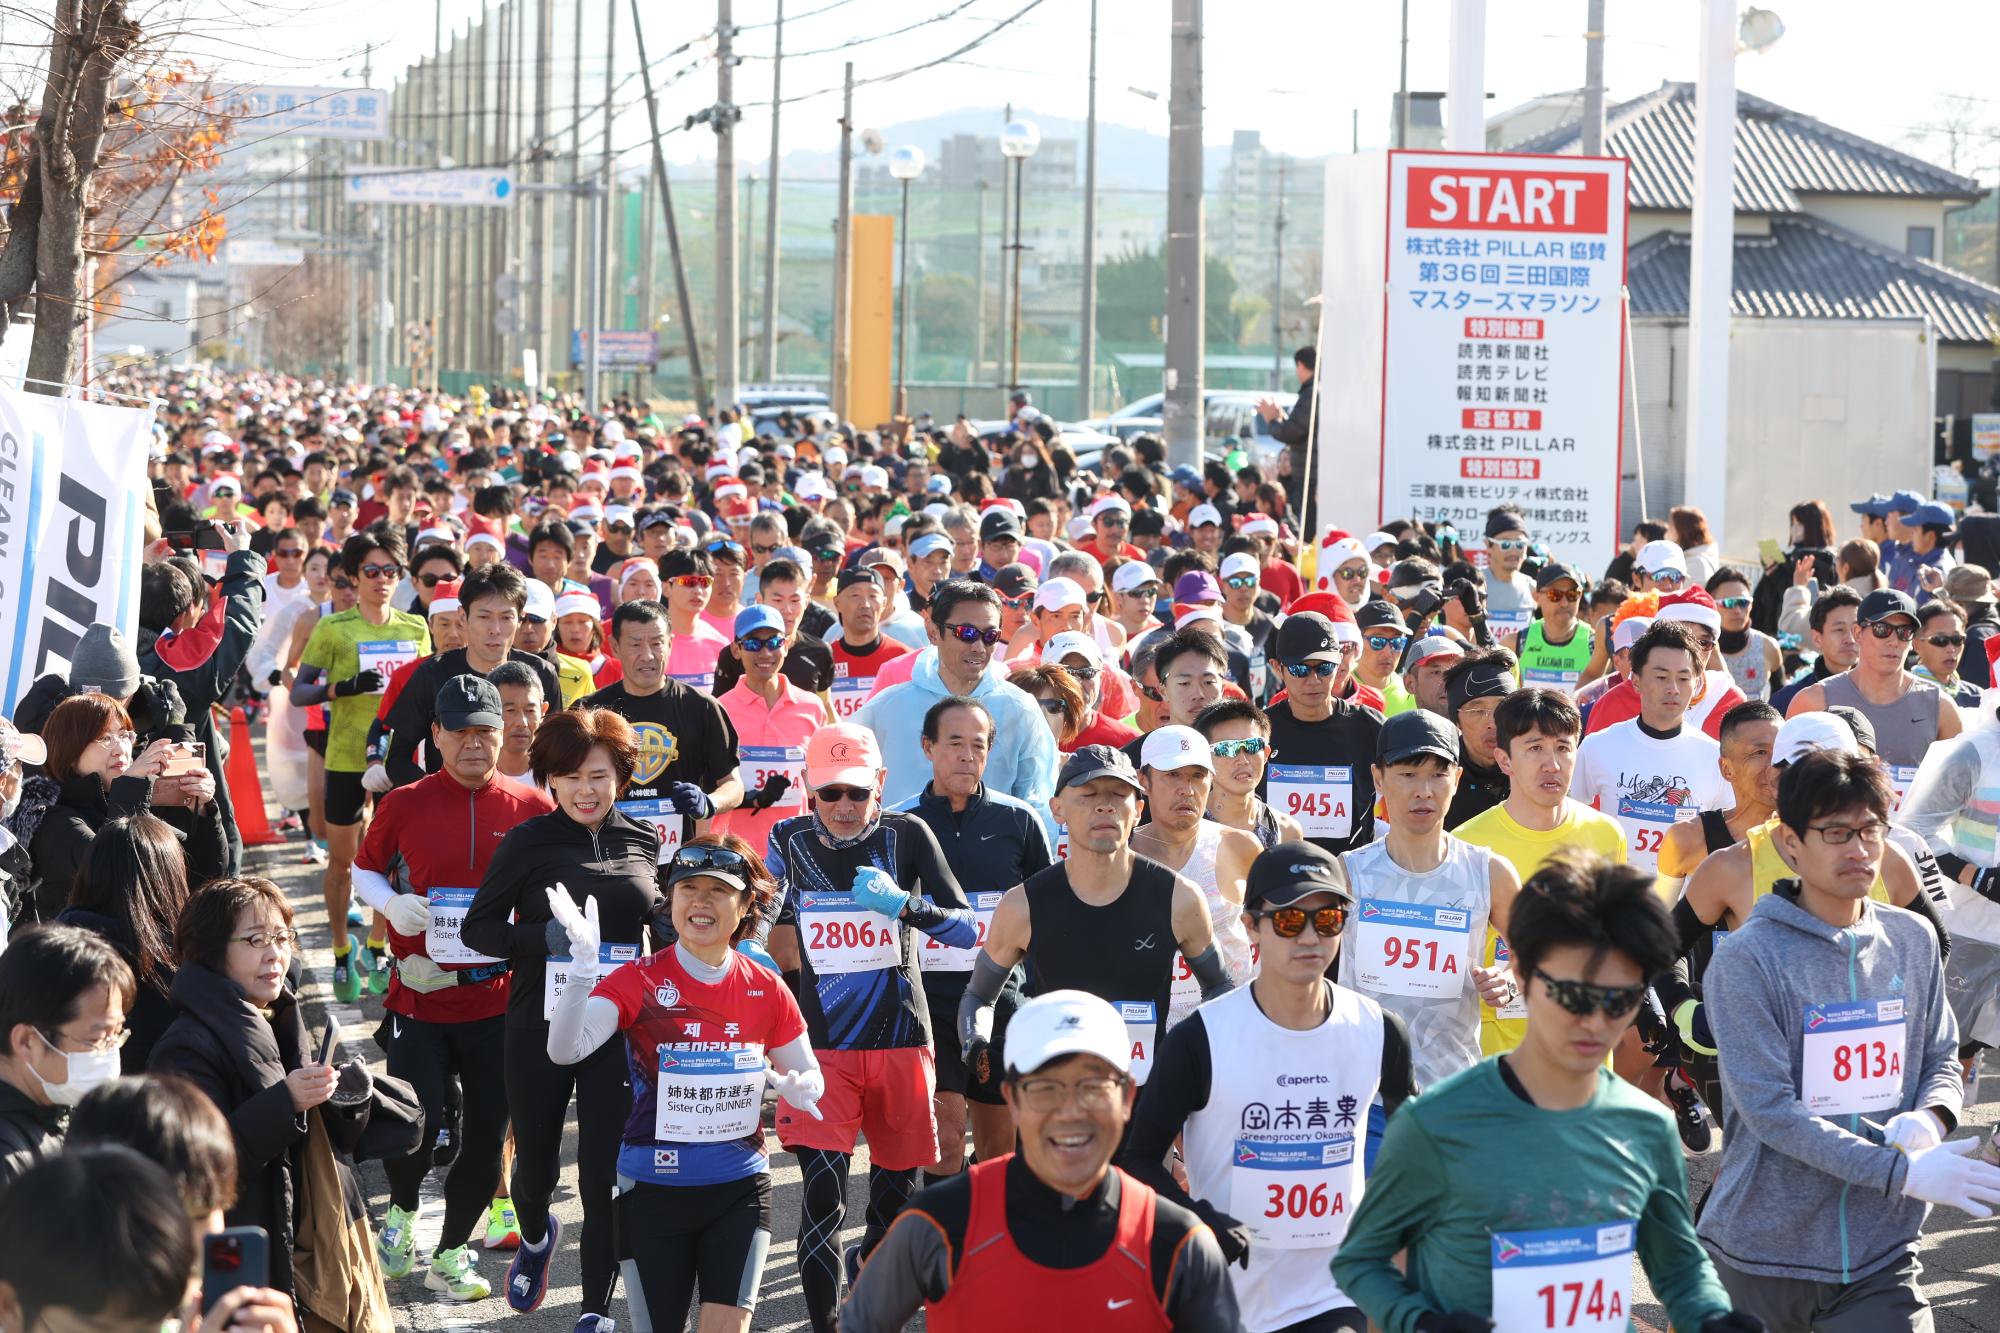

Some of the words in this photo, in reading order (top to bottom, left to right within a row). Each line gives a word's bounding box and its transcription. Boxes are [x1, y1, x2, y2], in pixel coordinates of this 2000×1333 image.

[1430, 175, 1586, 225] START
[1406, 238, 1480, 257] 株式会社
[1487, 241, 1564, 258] PILLAR
[1570, 242, 1606, 261] 協賛
[1409, 290, 1600, 313] マスターズマラソン
[1458, 343, 1549, 361] 読売新聞社
[1457, 364, 1548, 382] 読売テレビ
[1457, 385, 1548, 403] 報知新聞社
[1427, 434, 1496, 452] 株式会社
[1502, 436, 1576, 453] PILLAR
[1466, 459, 1535, 478] 特別協賛
[1410, 484, 1589, 502] 三菱電機モビリティ株式会社
[1412, 505, 1588, 523] トヨタカロー株式会社
[1287, 792, 1346, 817] 945A
[433, 929, 456, 940] Sister
[810, 921, 893, 950] 2806A
[1383, 936, 1457, 974] 951A
[1833, 1040, 1900, 1082] 813A
[667, 1083, 755, 1101] 姉妹都市選手
[667, 1101, 694, 1113] Sister
[695, 1103, 715, 1116] City
[715, 1098, 752, 1113] RUNNER
[1240, 1132, 1312, 1144] Greengrocery
[1263, 1182, 1344, 1219] 306A
[1537, 1278, 1623, 1329] 174A
